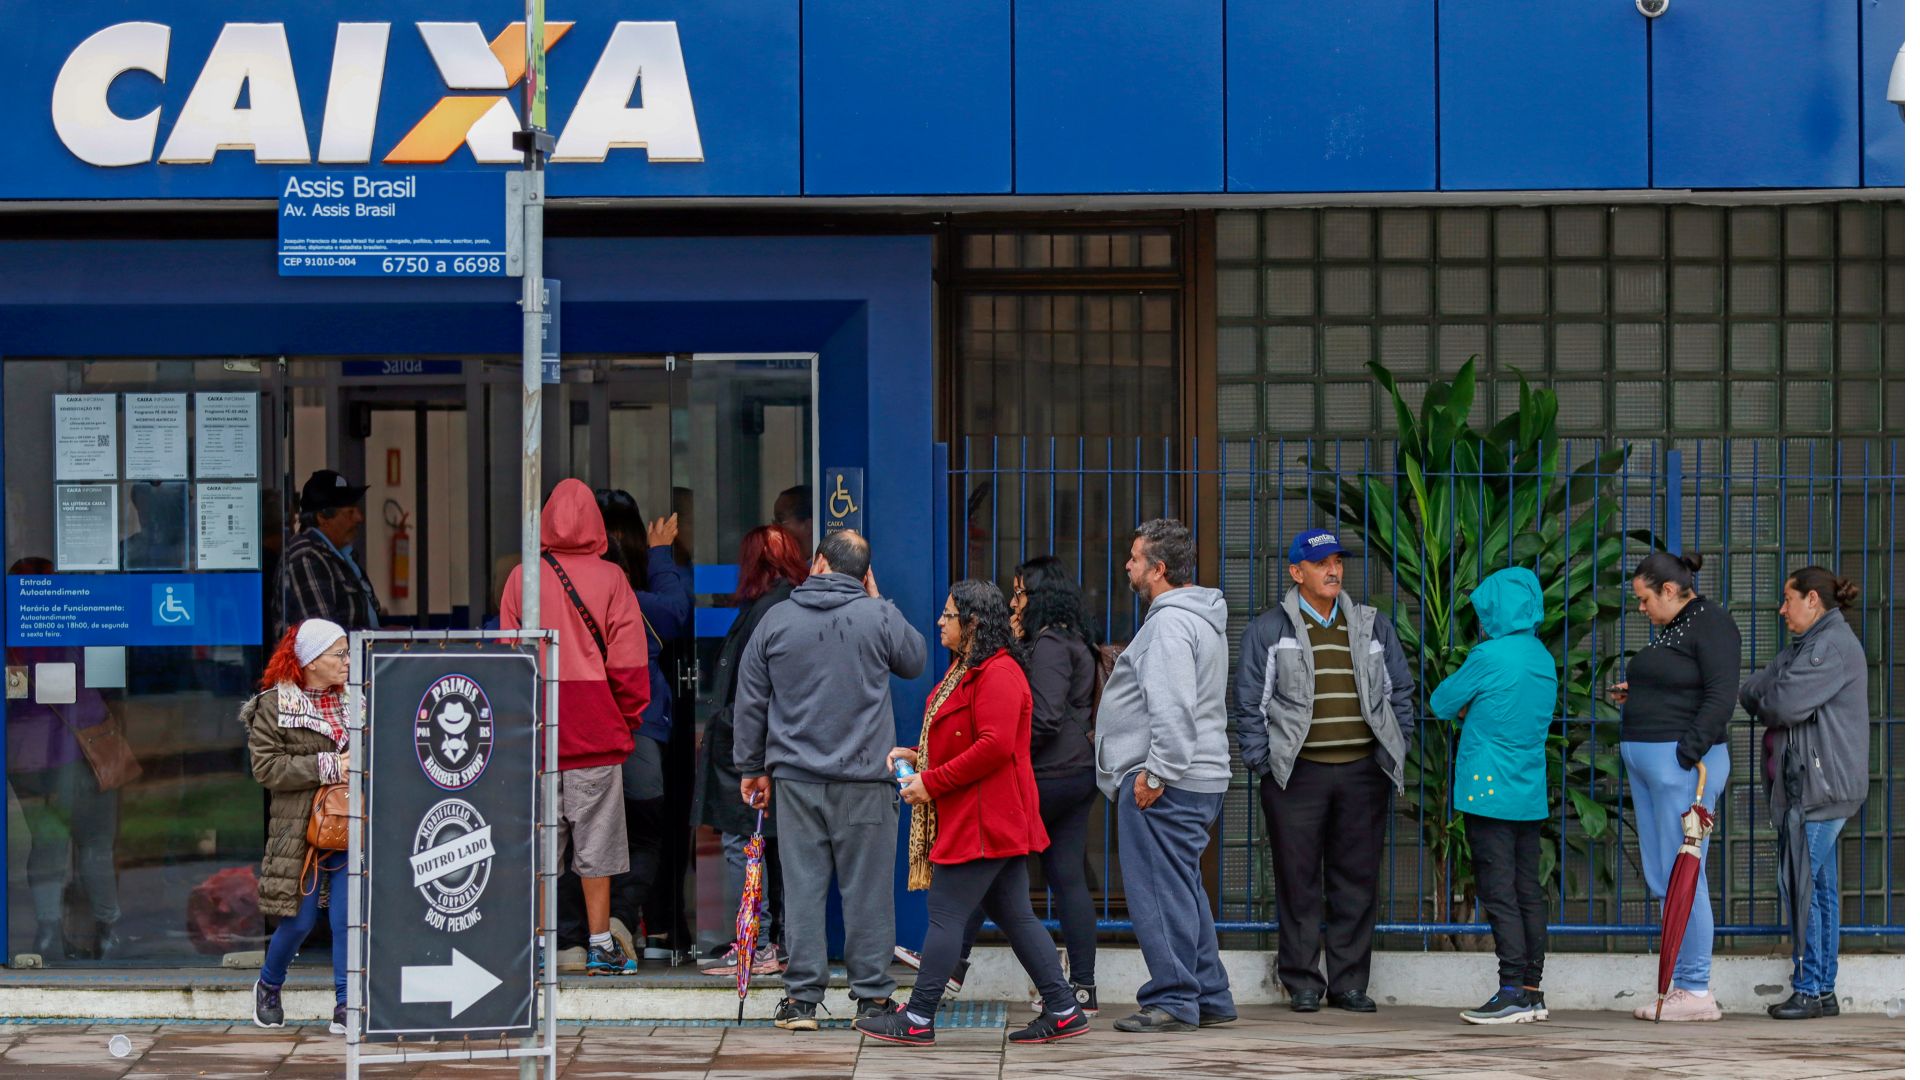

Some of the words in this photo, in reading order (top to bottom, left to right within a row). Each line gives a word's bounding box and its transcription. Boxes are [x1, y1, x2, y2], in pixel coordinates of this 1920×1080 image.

[52, 21, 704, 166] CAIXA
[284, 176, 344, 198] Assis
[353, 176, 416, 198] Brasil
[284, 203, 306, 217] Av.
[312, 203, 350, 217] Assis
[355, 203, 396, 217] Brasil
[283, 257, 302, 266] CEP
[305, 257, 356, 266] 91010-004
[382, 257, 429, 273] 6750
[436, 260, 446, 273] a
[454, 257, 500, 273] 6698
[20, 578, 52, 586] Entrada
[20, 588, 90, 596] Autoatendimento
[20, 604, 50, 612] Horário
[51, 604, 61, 612] de
[63, 604, 125, 612] Funcionamento:
[101, 622, 129, 631] segunda
[431, 677, 479, 702] PRIMUS
[416, 727, 430, 737] POA
[479, 726, 490, 738] RS
[424, 755, 460, 787] BARBER
[461, 753, 485, 783] SHOP
[416, 851, 455, 875] OUTRO
[459, 838, 487, 859] LADO
[438, 883, 480, 907] CORPORAL
[425, 908, 446, 931] BODY
[448, 906, 482, 932] PIERCING
